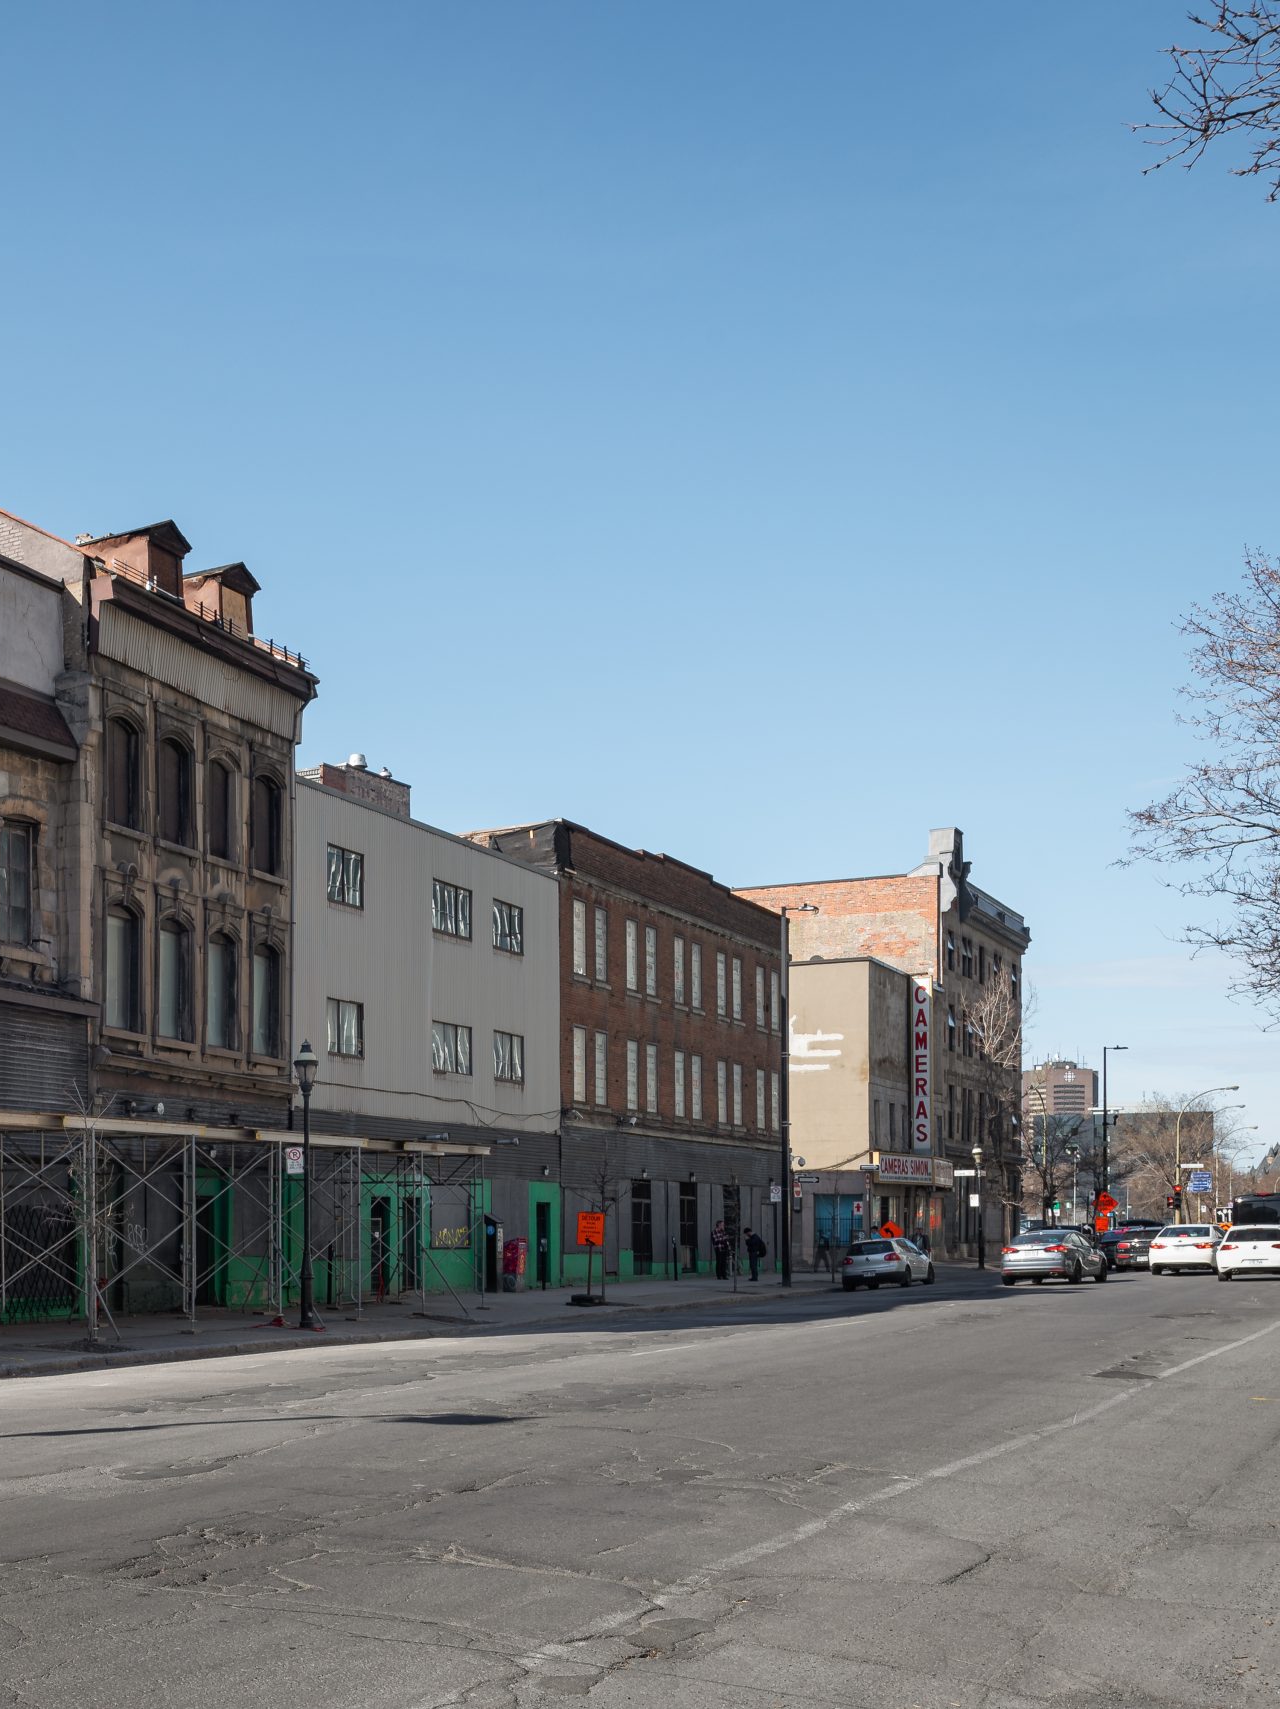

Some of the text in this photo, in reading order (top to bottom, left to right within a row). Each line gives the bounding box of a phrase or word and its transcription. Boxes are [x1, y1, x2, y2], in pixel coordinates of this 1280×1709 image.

[914, 985, 928, 1143] CAMERAS
[880, 1157, 908, 1174] CAMERAS
[910, 1160, 929, 1176] SIMON
